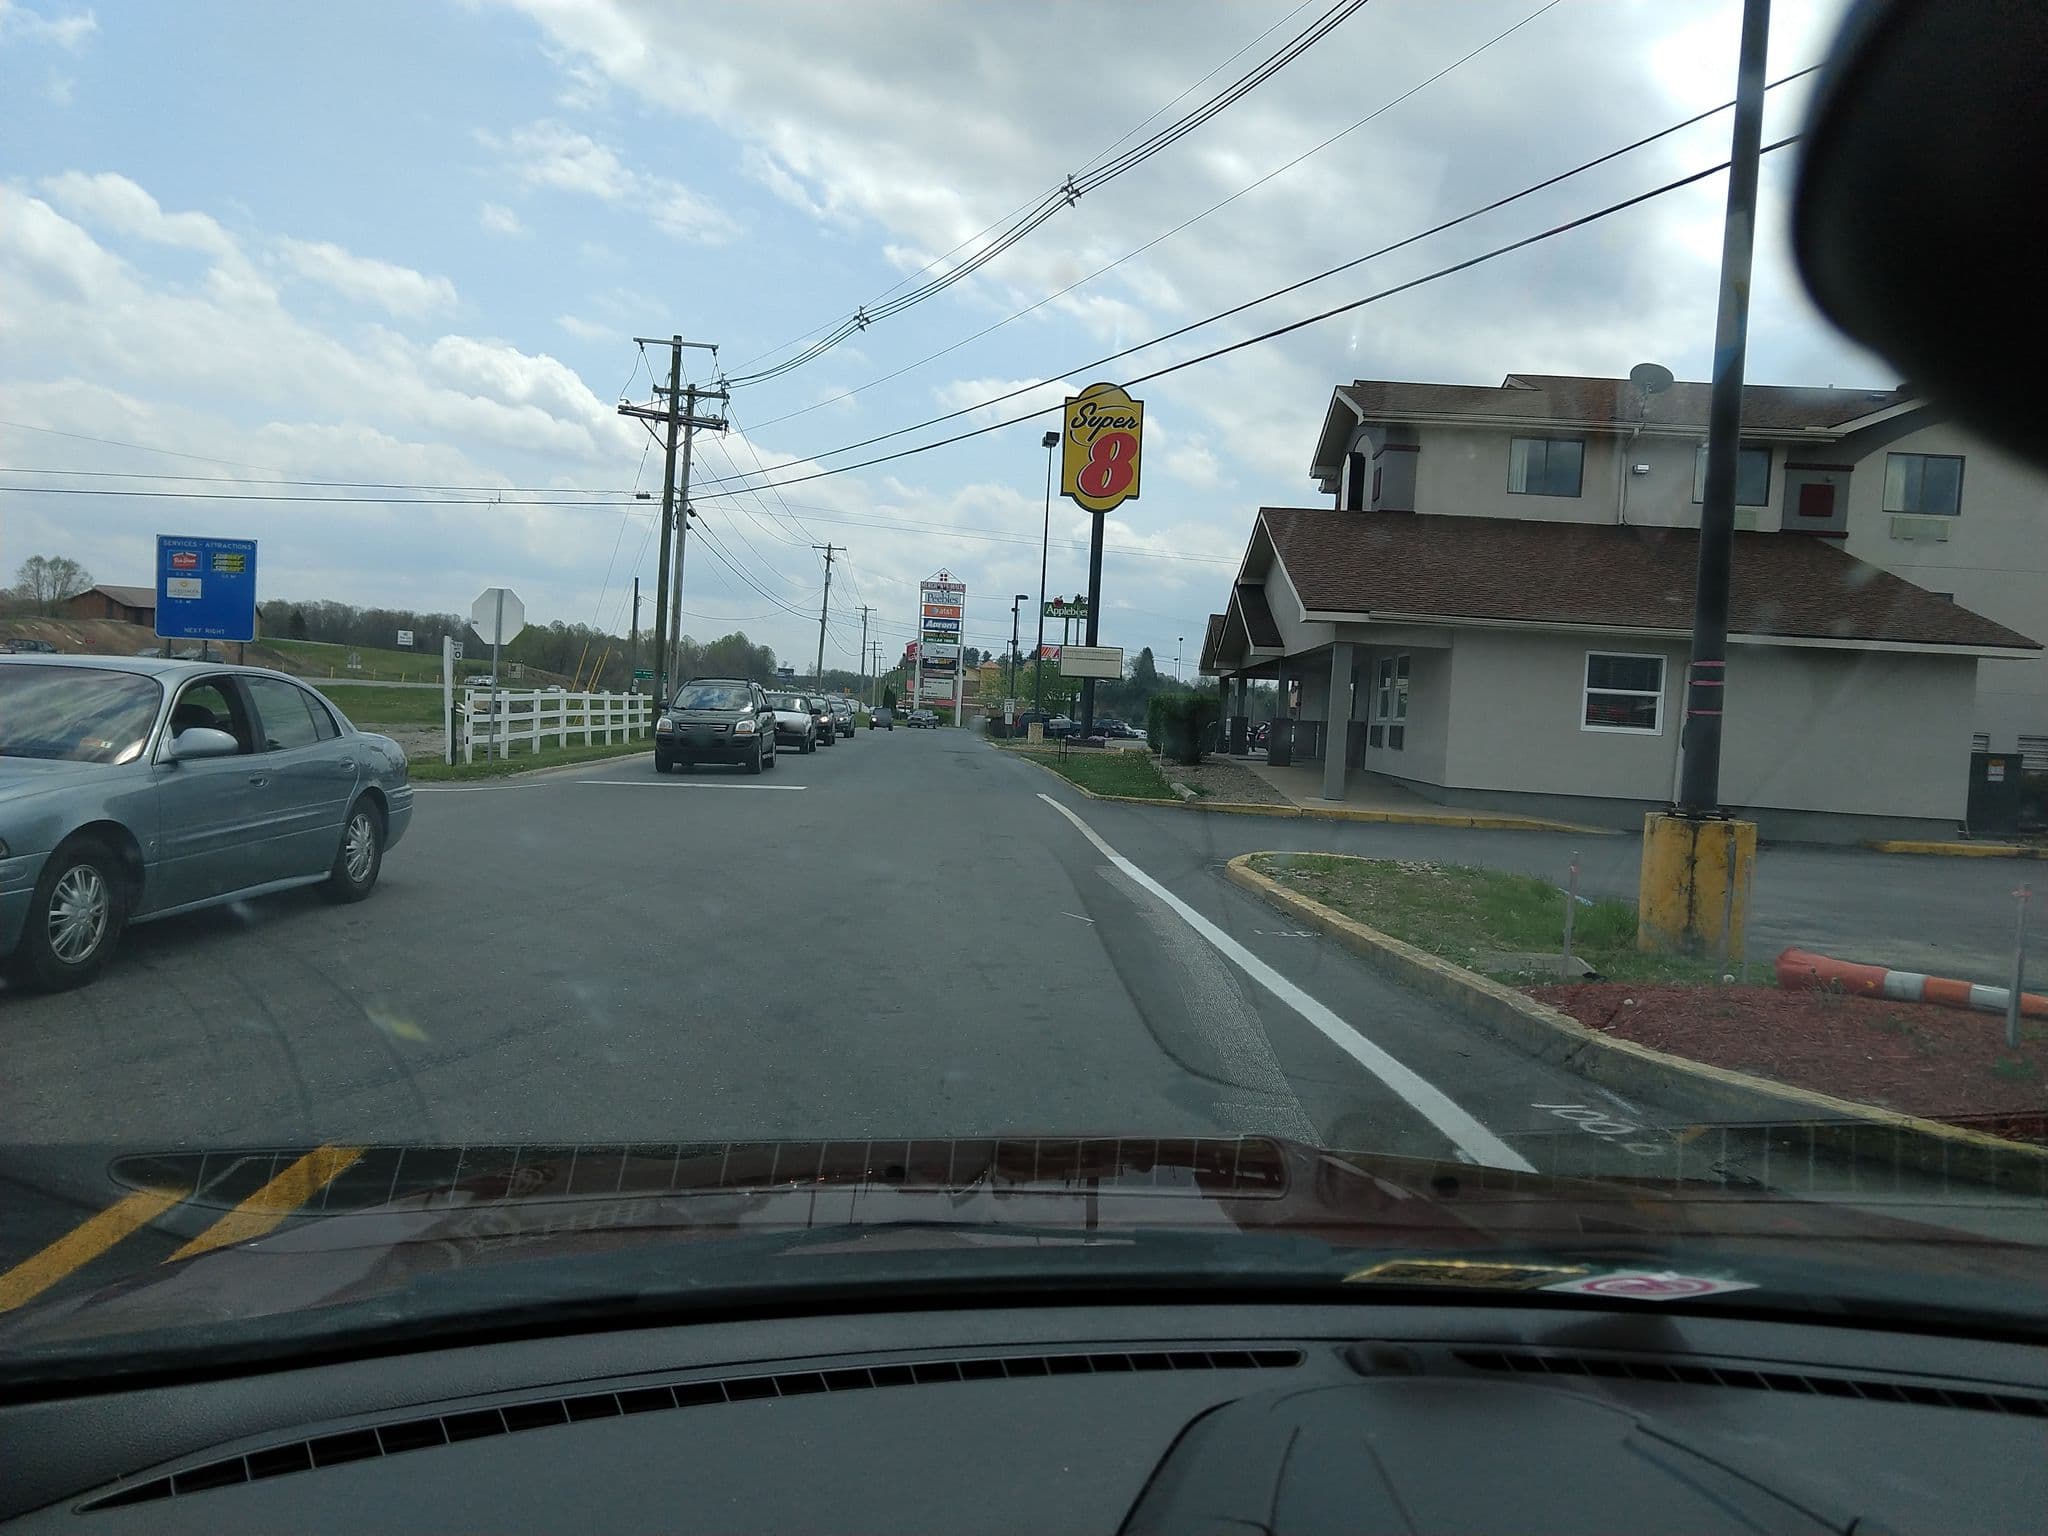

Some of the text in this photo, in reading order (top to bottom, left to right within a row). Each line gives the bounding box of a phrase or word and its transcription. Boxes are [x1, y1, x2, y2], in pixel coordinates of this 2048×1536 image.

[1071, 402, 1139, 442] Super
[1077, 432, 1138, 498] 8
[927, 591, 959, 604] Peebles
